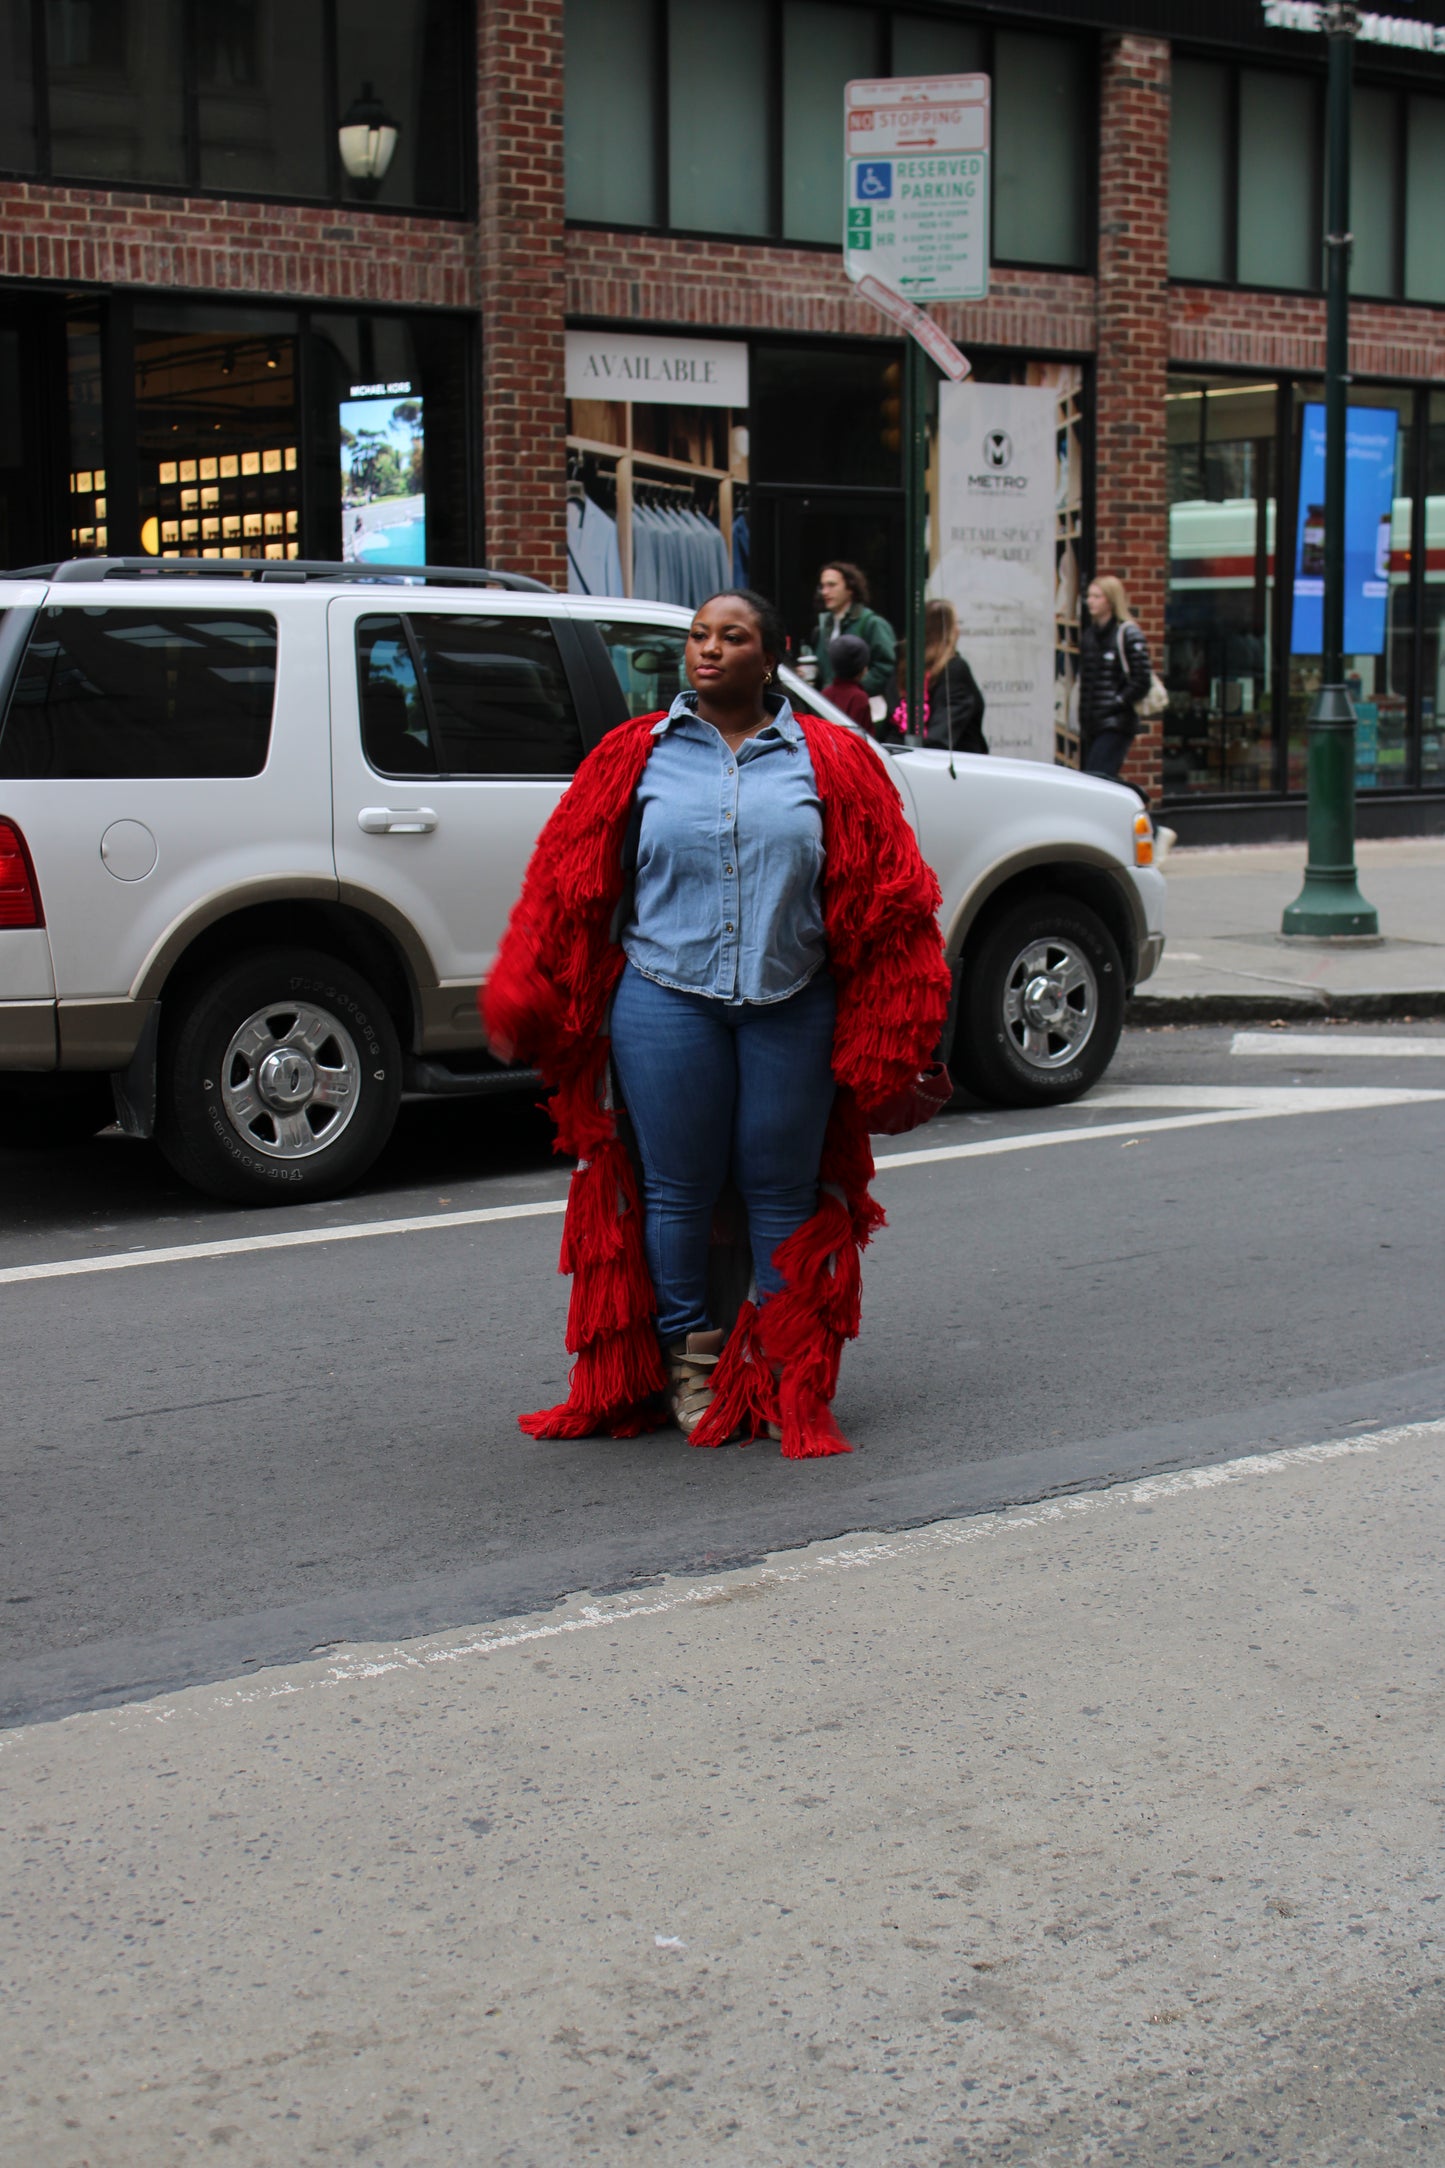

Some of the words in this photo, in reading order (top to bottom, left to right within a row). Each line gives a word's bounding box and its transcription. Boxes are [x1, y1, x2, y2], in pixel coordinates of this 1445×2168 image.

[850, 113, 874, 130] NO
[880, 110, 963, 129] STOPPING
[897, 159, 980, 179] RESERVED
[902, 181, 976, 200] PARKING
[855, 210, 865, 224] 2
[876, 208, 896, 224] HR
[855, 233, 865, 247] 3
[876, 231, 896, 247] HR
[583, 354, 718, 384] AVAILABLE
[967, 474, 1027, 490] METRO
[951, 526, 997, 543] RETAIL
[287, 976, 380, 1055] Firestone
[208, 1105, 303, 1181] Firestone
